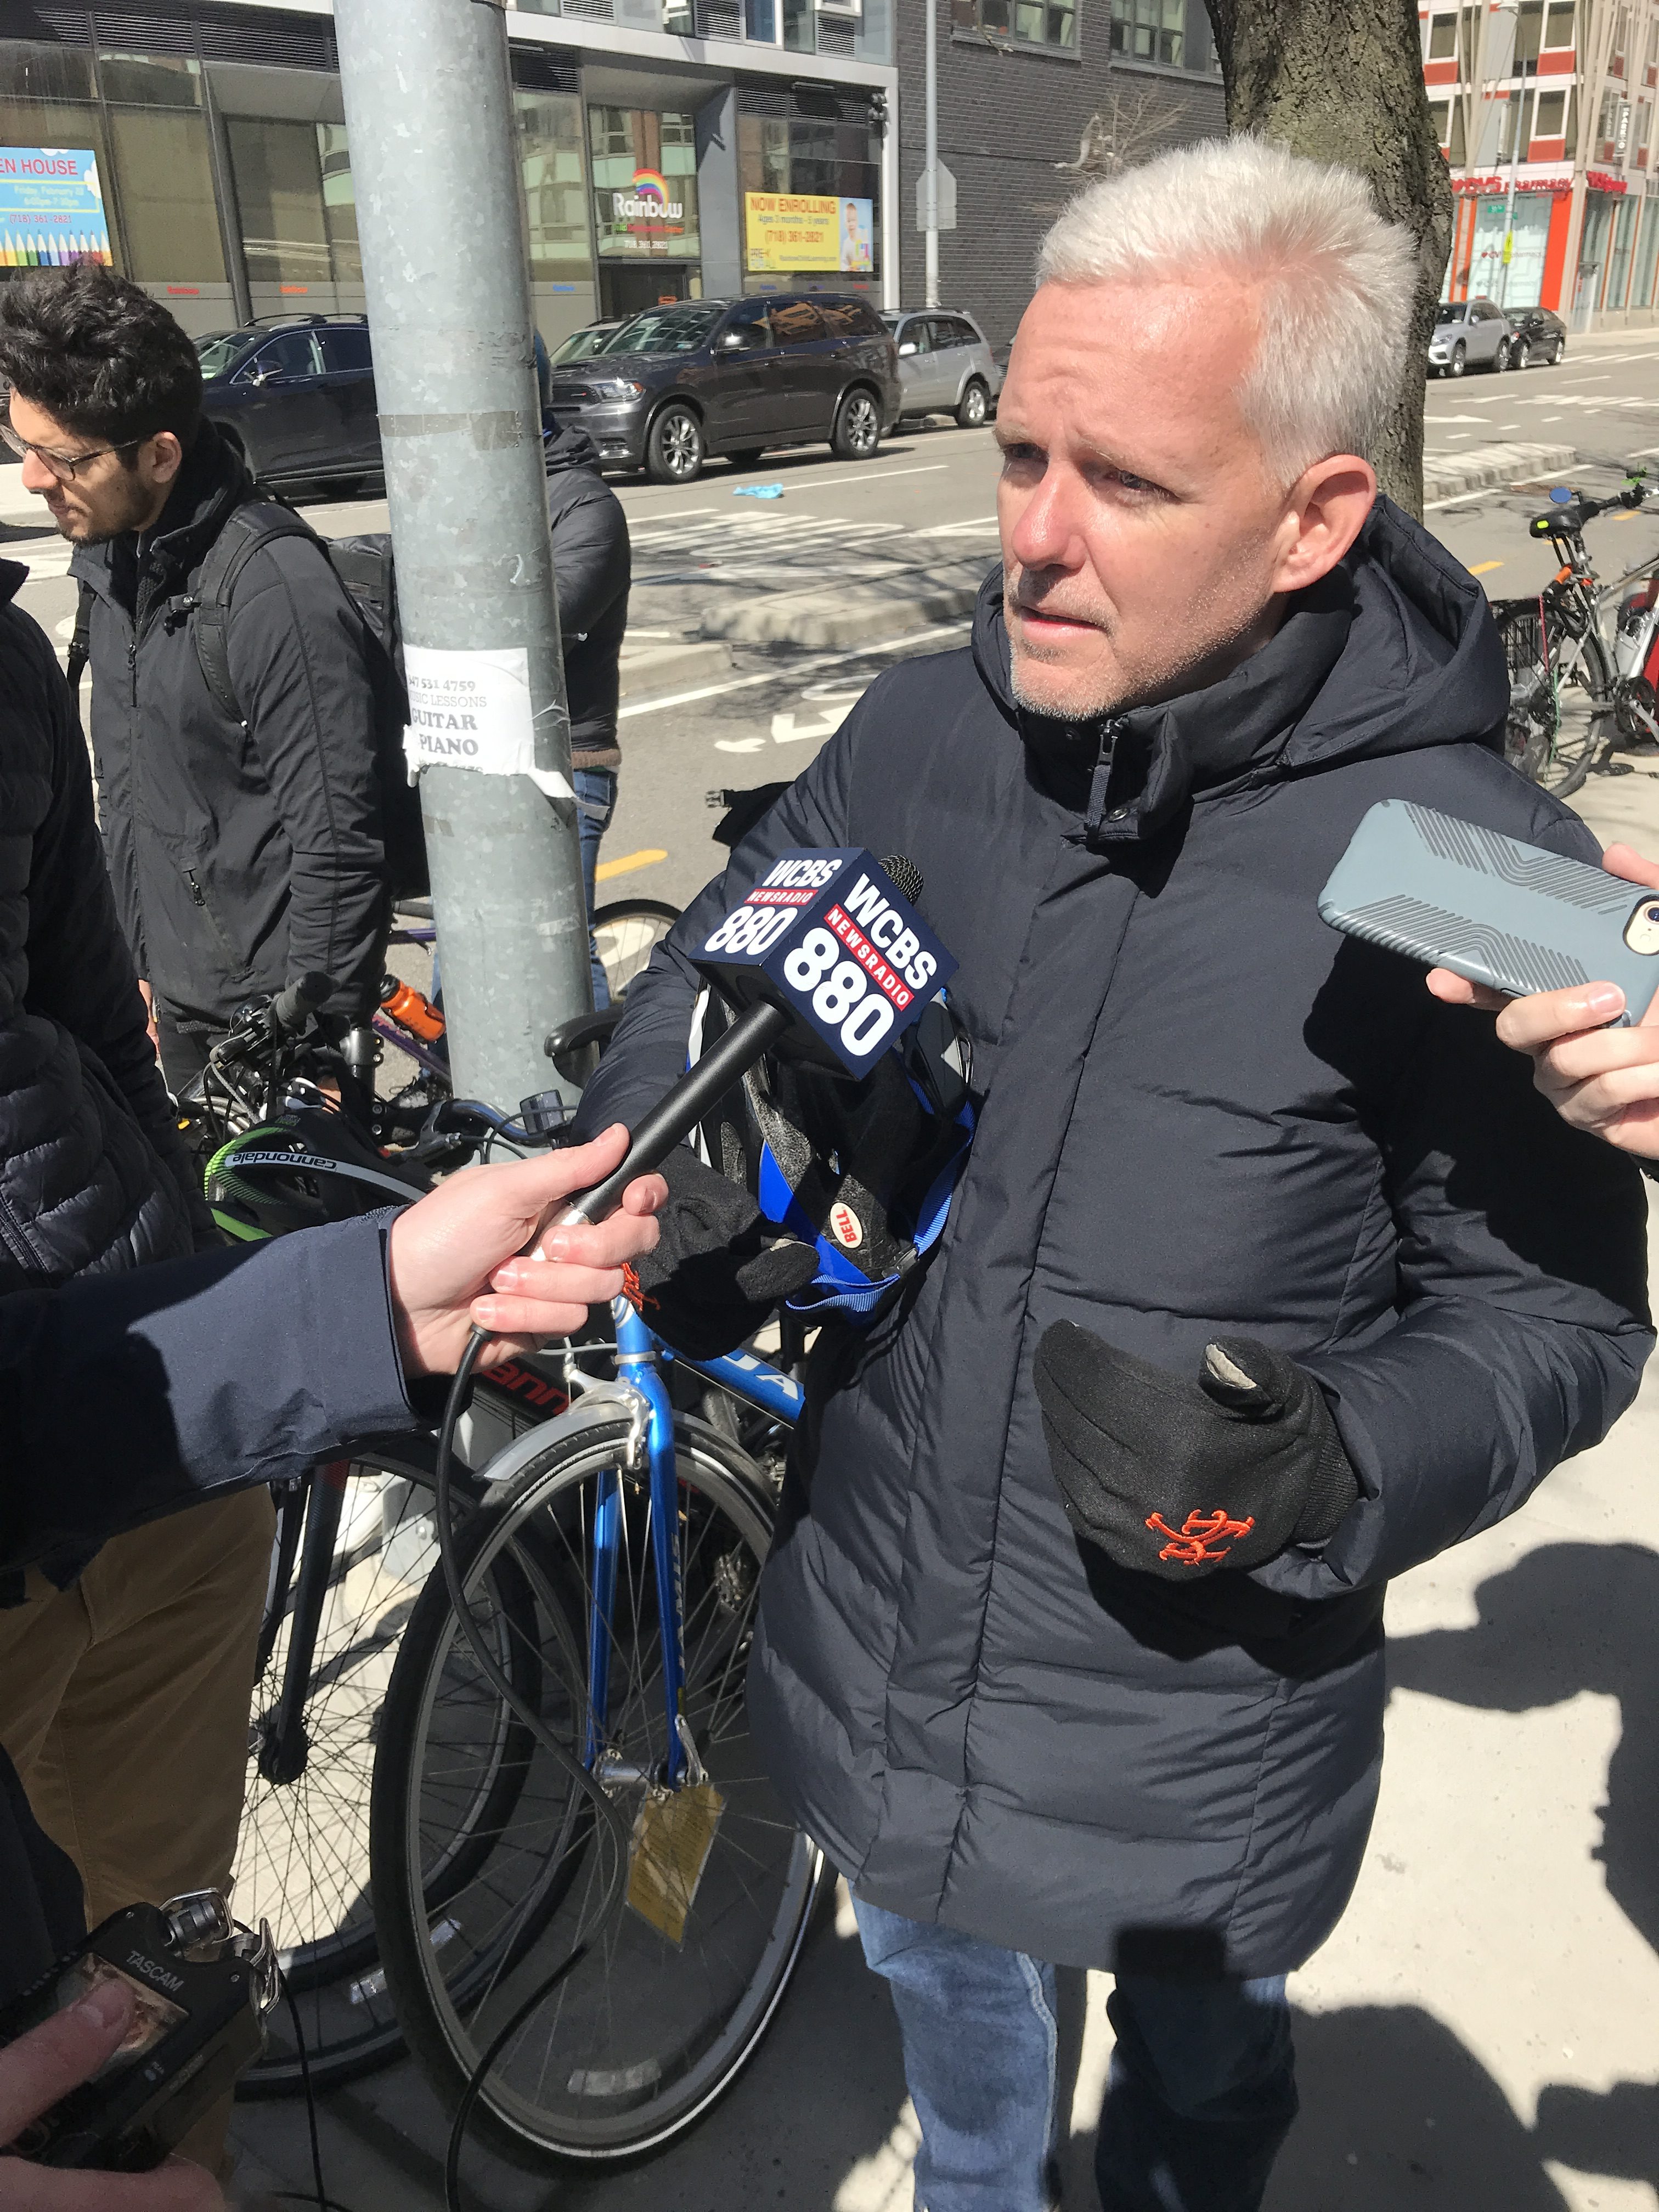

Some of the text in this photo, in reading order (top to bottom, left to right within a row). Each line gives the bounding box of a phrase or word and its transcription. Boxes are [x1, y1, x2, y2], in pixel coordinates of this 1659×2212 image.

[21, 159, 78, 175] HOUSE
[751, 197, 837, 215] NOW ENROLLING
[9, 214, 31, 224] (718)
[34, 215, 72, 223] 361-2821
[421, 678, 439, 689] 531
[443, 680, 476, 692] 4759
[430, 695, 487, 708] LESSONS
[411, 707, 478, 730] GUITAR
[419, 733, 478, 756] PIANO
[762, 859, 843, 888] WCBS
[747, 890, 814, 904] NEWSRADIO
[704, 906, 798, 956] 880
[843, 873, 938, 990] WCBS
[827, 908, 909, 1006] NEWSRADIO
[783, 927, 894, 1057] 880
[233, 1152, 337, 1170] cannondale
[836, 1209, 857, 1243] BELL
[126, 1950, 185, 1993] TASCAM
